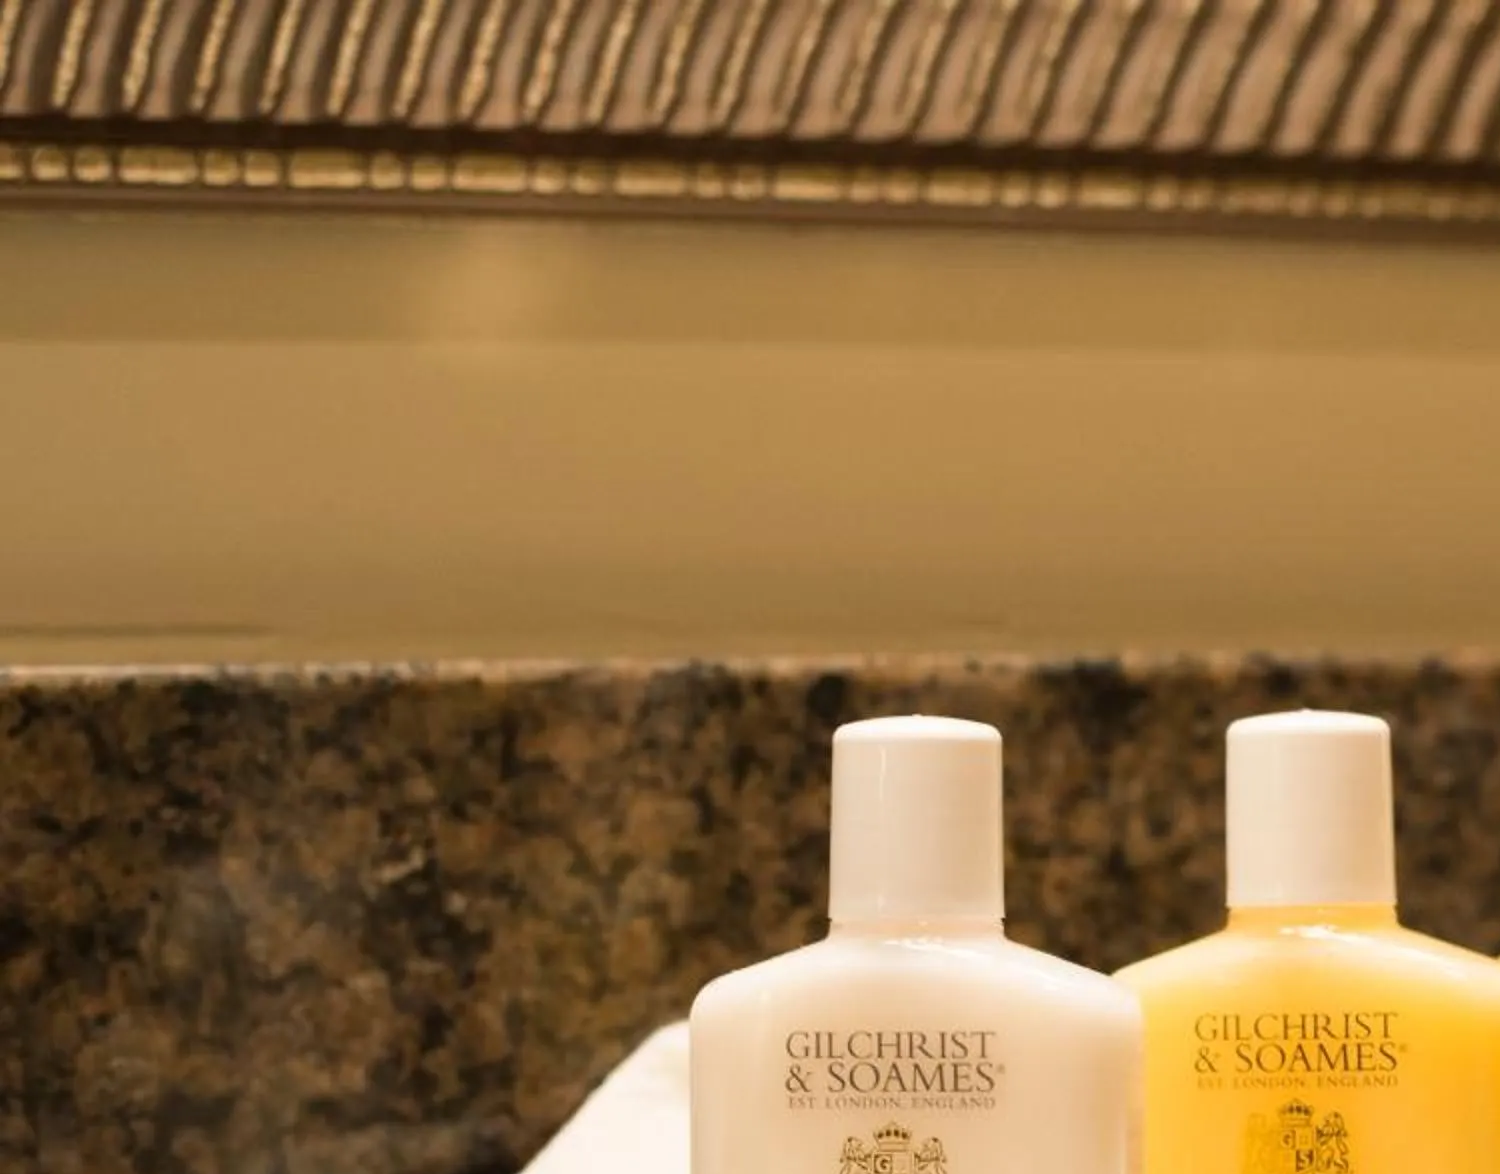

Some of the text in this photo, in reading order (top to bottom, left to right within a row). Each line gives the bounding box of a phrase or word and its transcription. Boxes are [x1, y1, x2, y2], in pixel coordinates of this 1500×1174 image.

[1194, 1012, 1398, 1041] GILCHRIST
[785, 1031, 996, 1060] GILCHRIST
[1194, 1046, 1218, 1074] &
[784, 1063, 811, 1093] &
[1317, 1074, 1399, 1089] ENGLAND
[911, 1097, 996, 1109] ENGLAND
